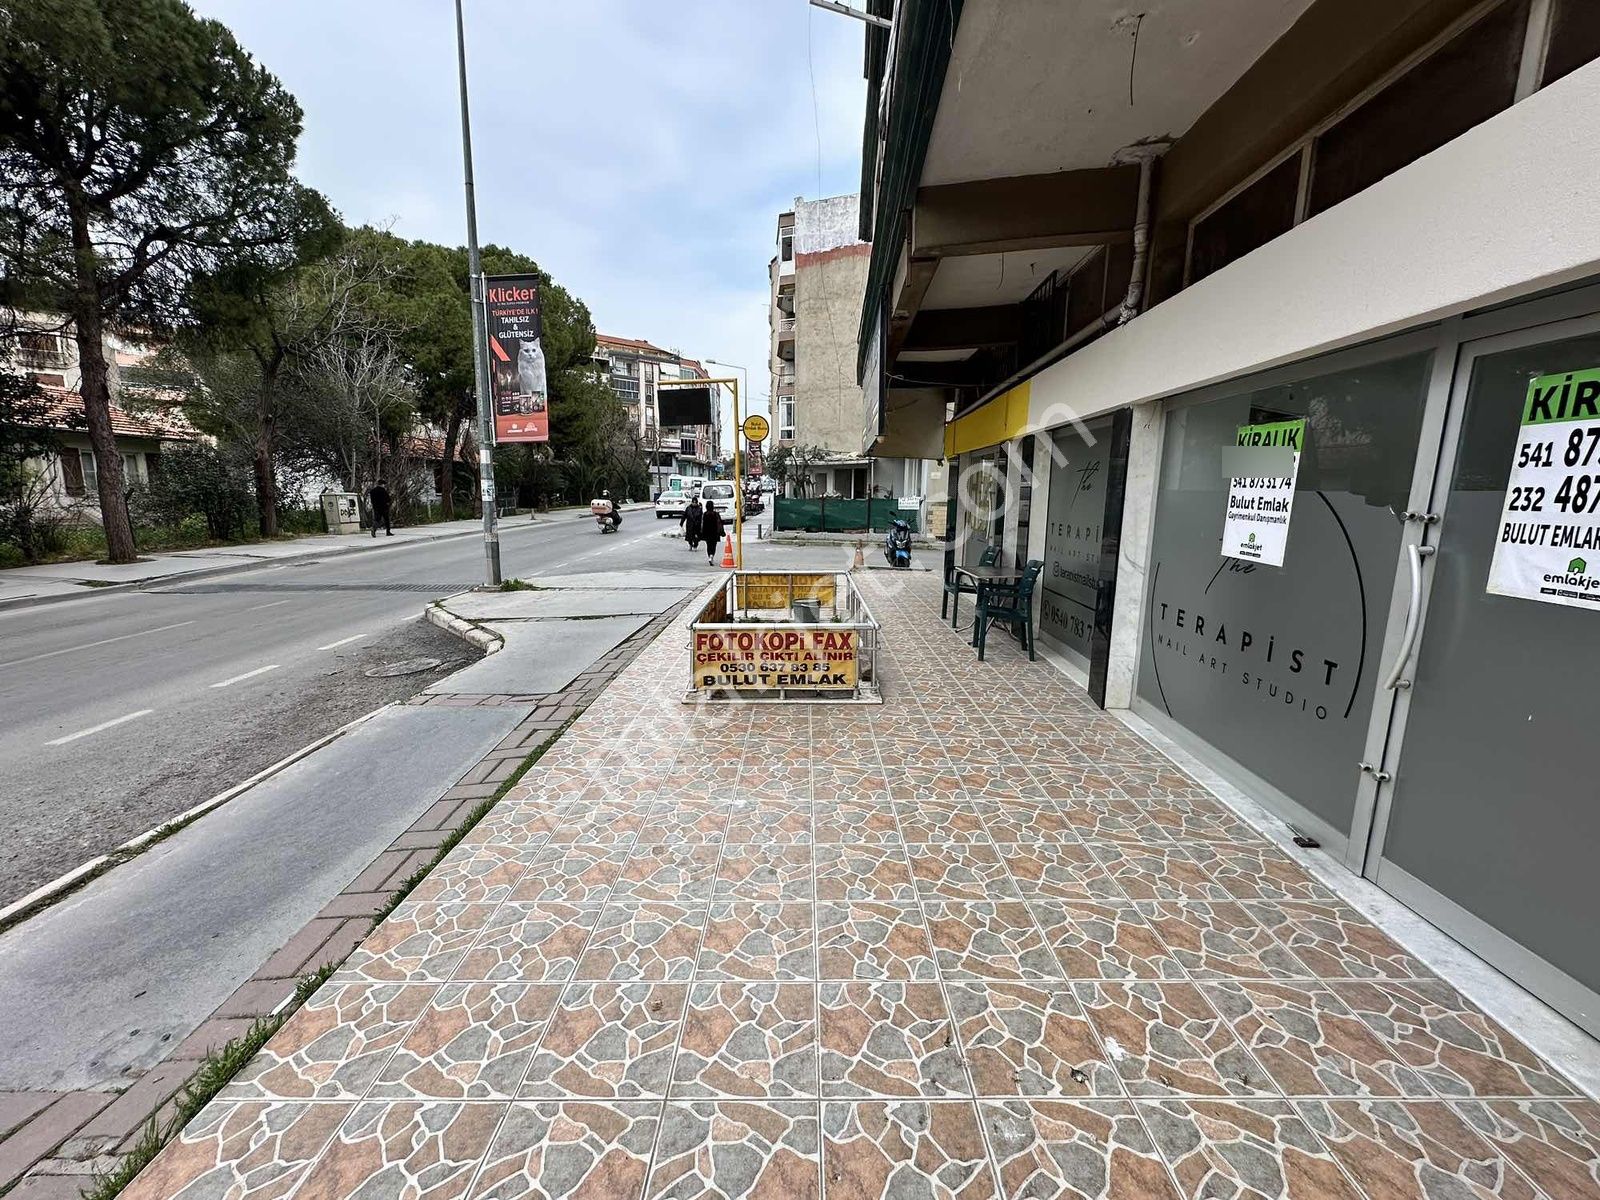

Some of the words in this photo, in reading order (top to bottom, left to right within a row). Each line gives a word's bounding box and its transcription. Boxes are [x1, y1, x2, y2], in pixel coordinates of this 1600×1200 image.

[489, 286, 536, 302] Klicker
[498, 330, 534, 338] GLÜTENSİZ
[1518, 442, 1553, 468] 541
[1564, 428, 1600, 467] 87
[1230, 495, 1255, 510] Bulut
[1257, 496, 1289, 512] Emlak
[1508, 487, 1545, 511] 232
[1501, 523, 1551, 545] BULUT
[813, 633, 852, 650] FAX
[1160, 603, 1338, 686] TERAPİST
[720, 663, 755, 672] 0530
[760, 663, 785, 672] 637
[813, 663, 830, 672] 85
[1158, 633, 1187, 655] NAIL
[1199, 653, 1227, 674] ART
[1242, 672, 1327, 719] STUDIO
[703, 674, 770, 686] BULUT
[777, 674, 846, 684] EMLAK
